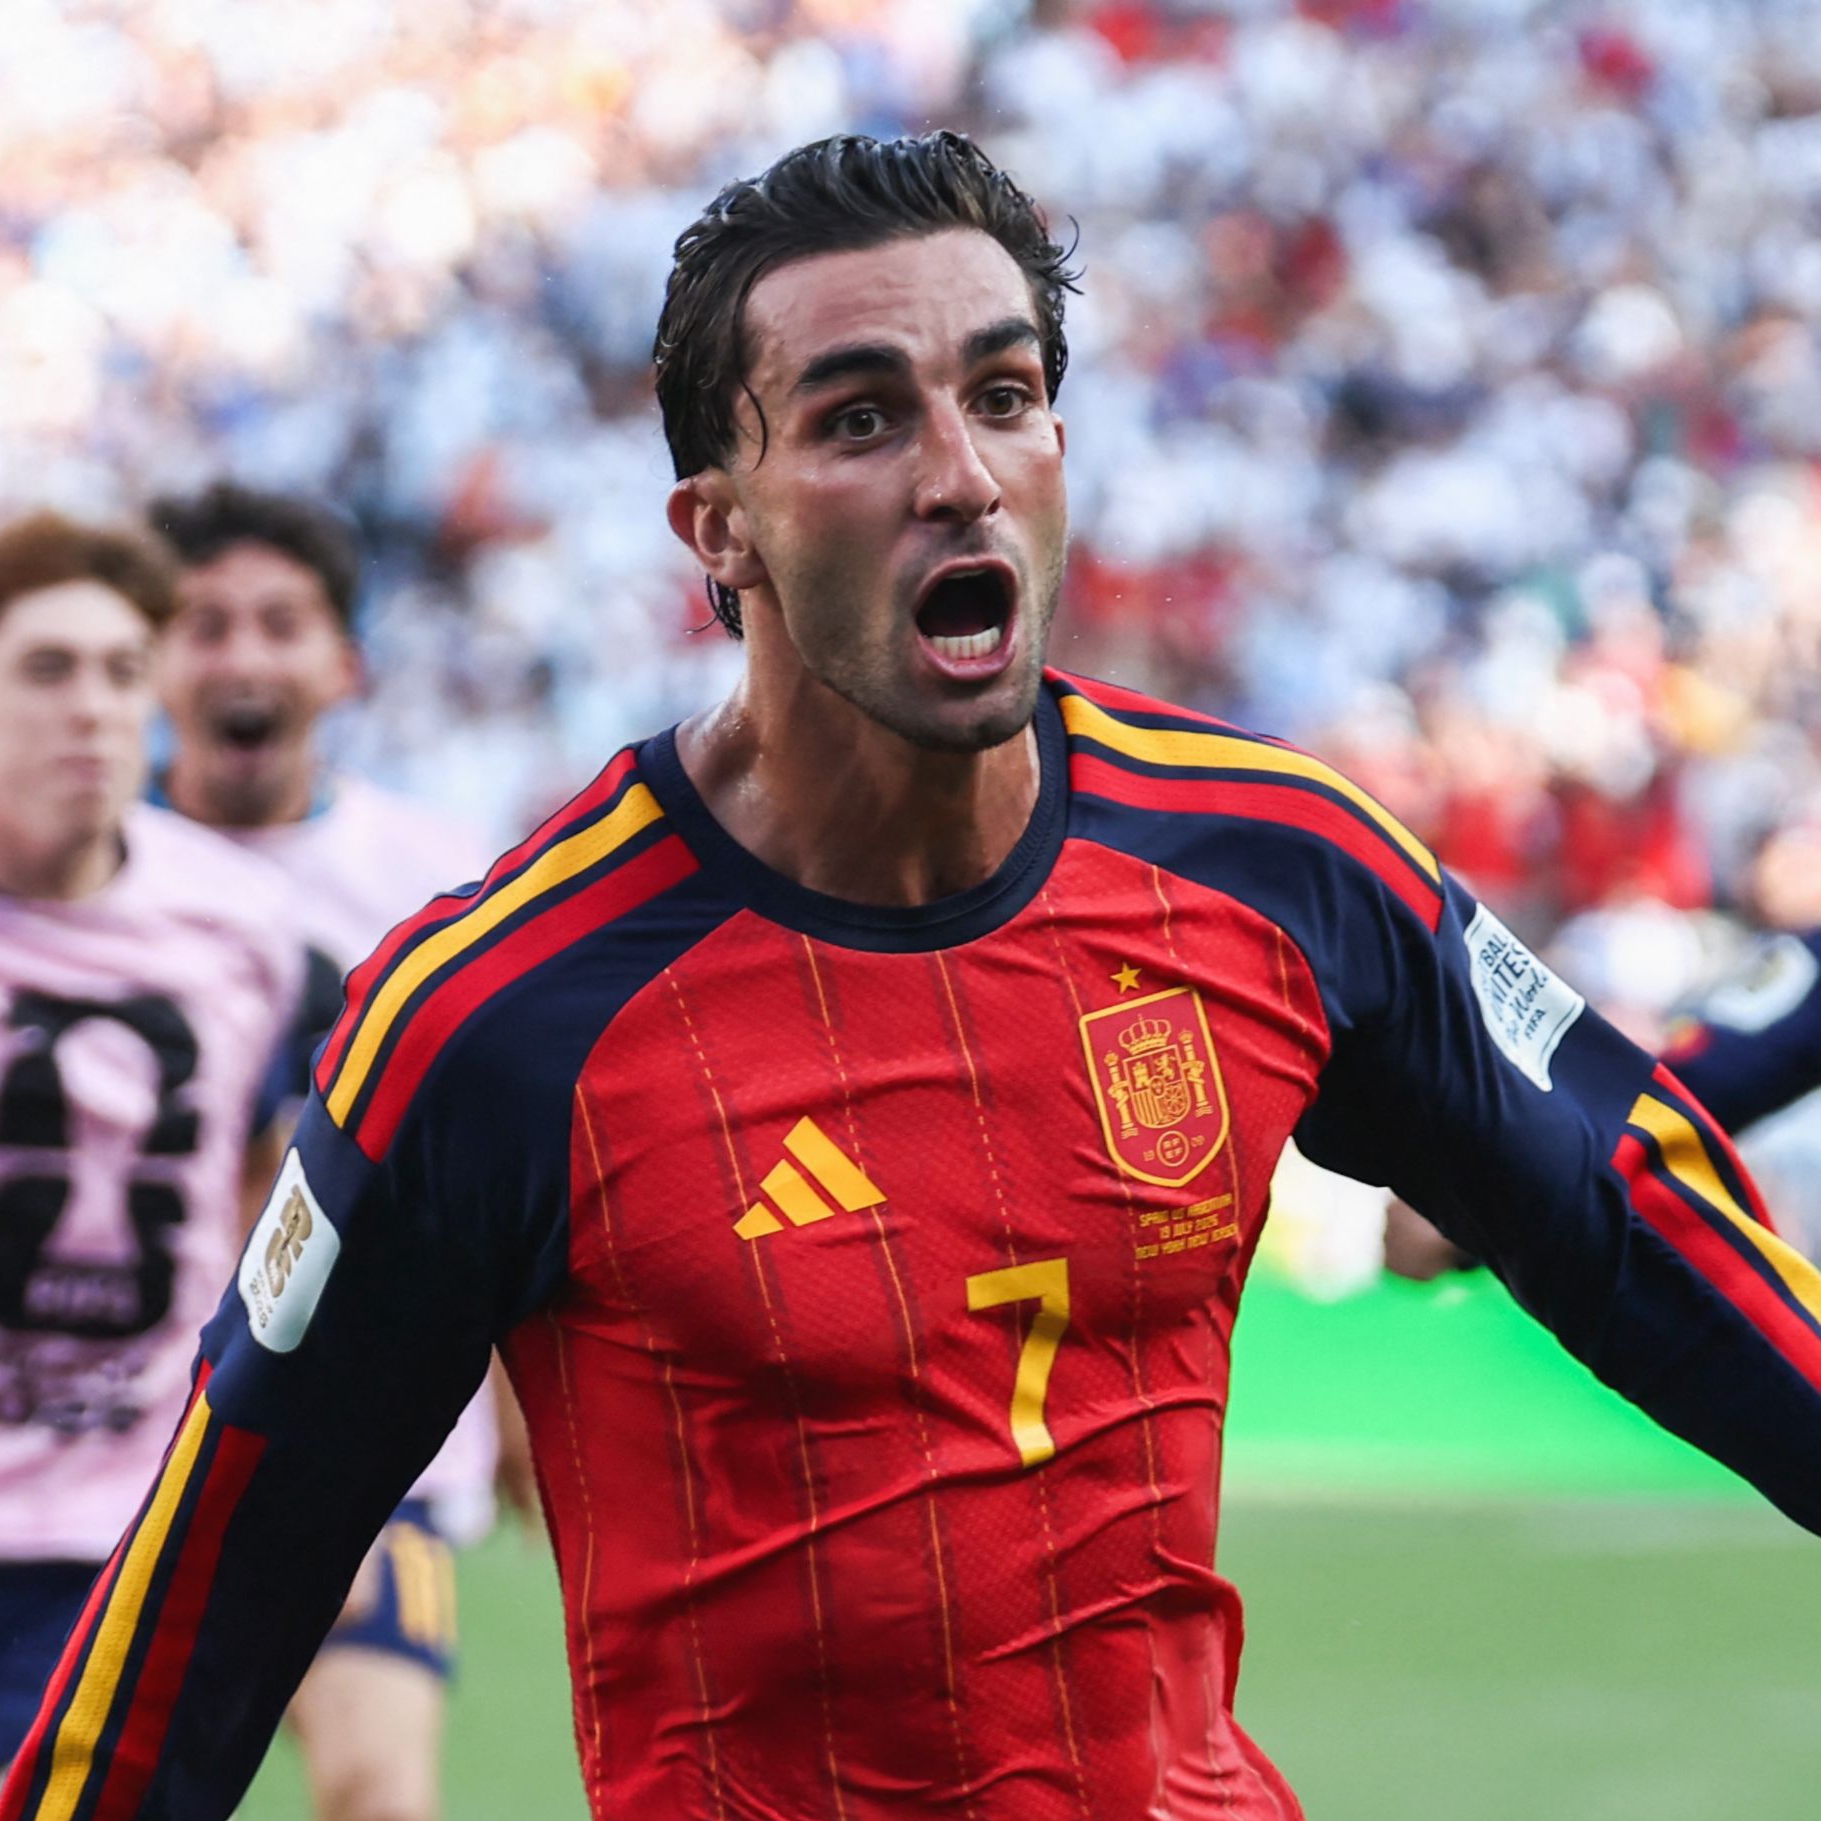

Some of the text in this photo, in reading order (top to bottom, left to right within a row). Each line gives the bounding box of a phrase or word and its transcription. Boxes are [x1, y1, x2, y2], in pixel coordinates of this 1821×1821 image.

[1525, 1009, 1547, 1040] FIFA
[1140, 1211, 1169, 1227] SPAIN
[1172, 1220, 1194, 1238] JULY
[966, 1258, 1070, 1468] 7
